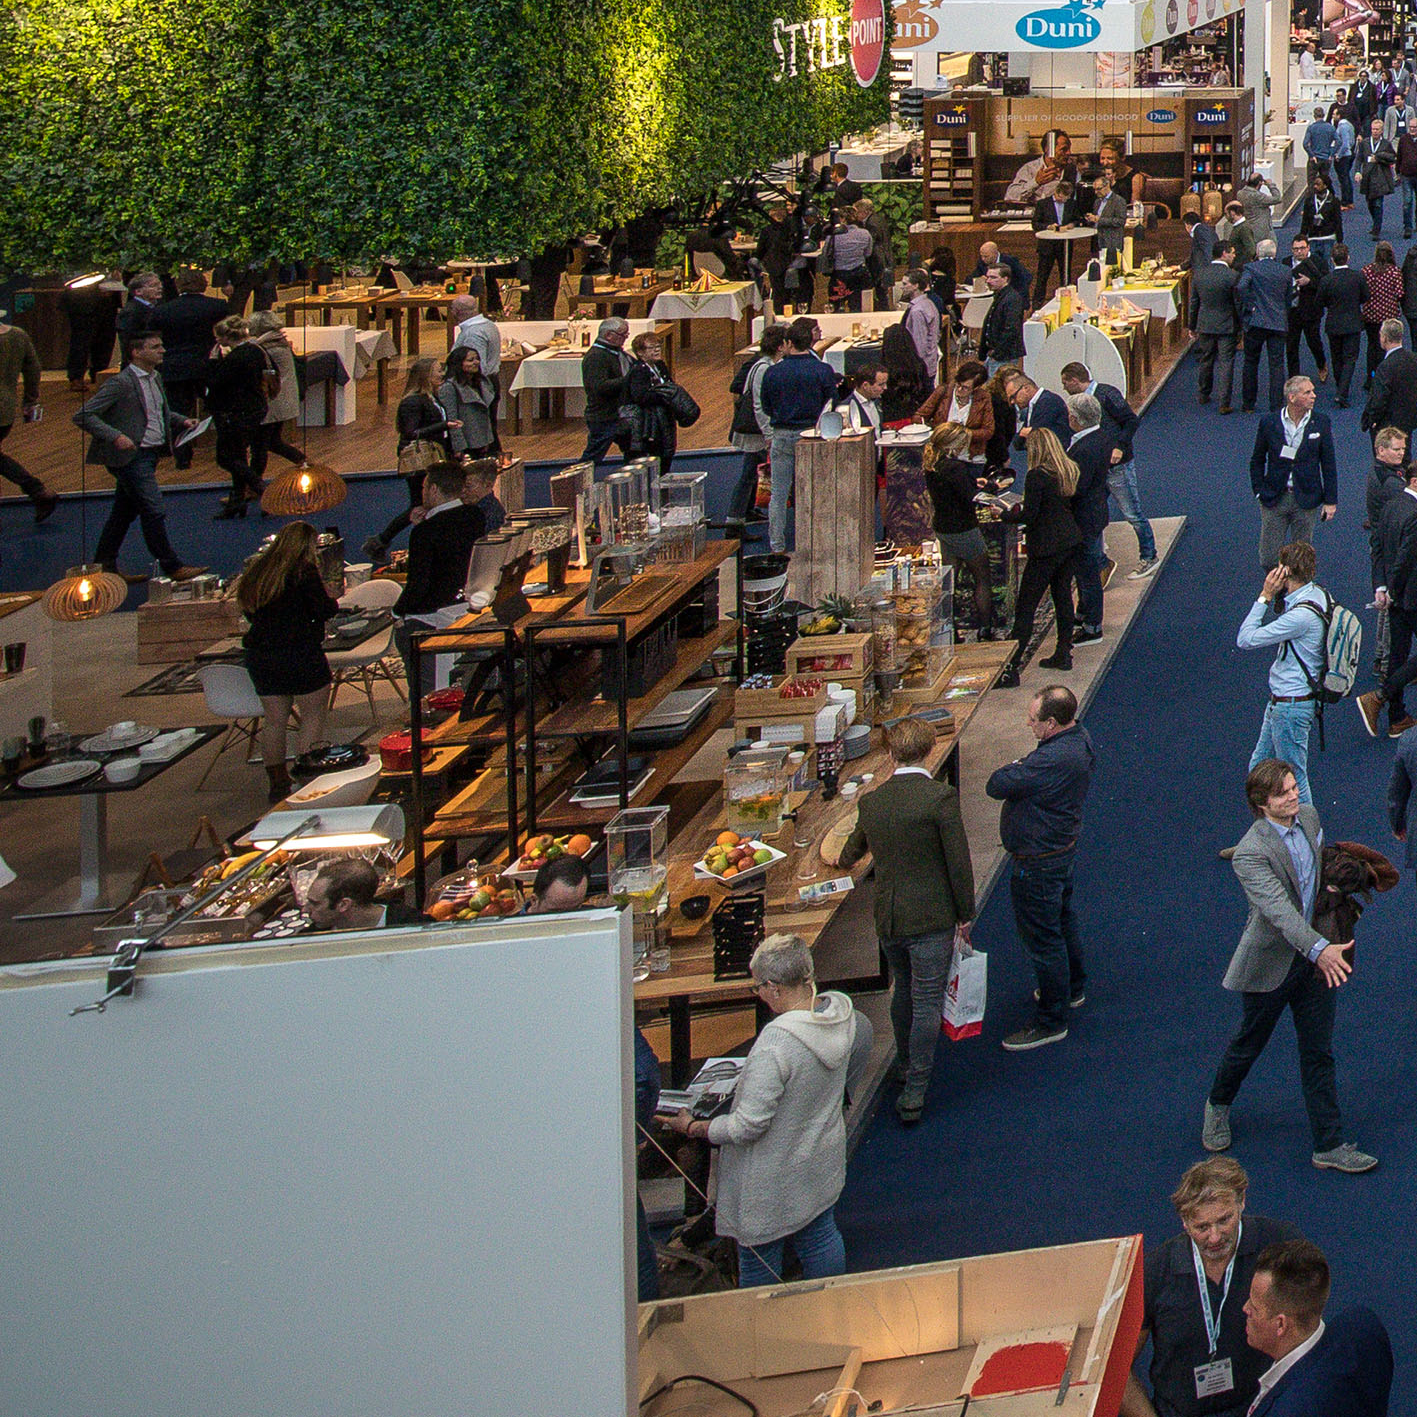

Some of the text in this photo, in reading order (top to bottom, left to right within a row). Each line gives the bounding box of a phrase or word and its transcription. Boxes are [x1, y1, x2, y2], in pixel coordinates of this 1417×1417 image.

[852, 16, 883, 47] POINT
[1026, 16, 1092, 38] Duni
[936, 113, 967, 125] Duni
[995, 113, 1039, 123] SUPPLIER
[1055, 113, 1140, 122] GOODFOODMOOD
[1149, 111, 1176, 122] Duni
[1197, 111, 1227, 123] Duni
